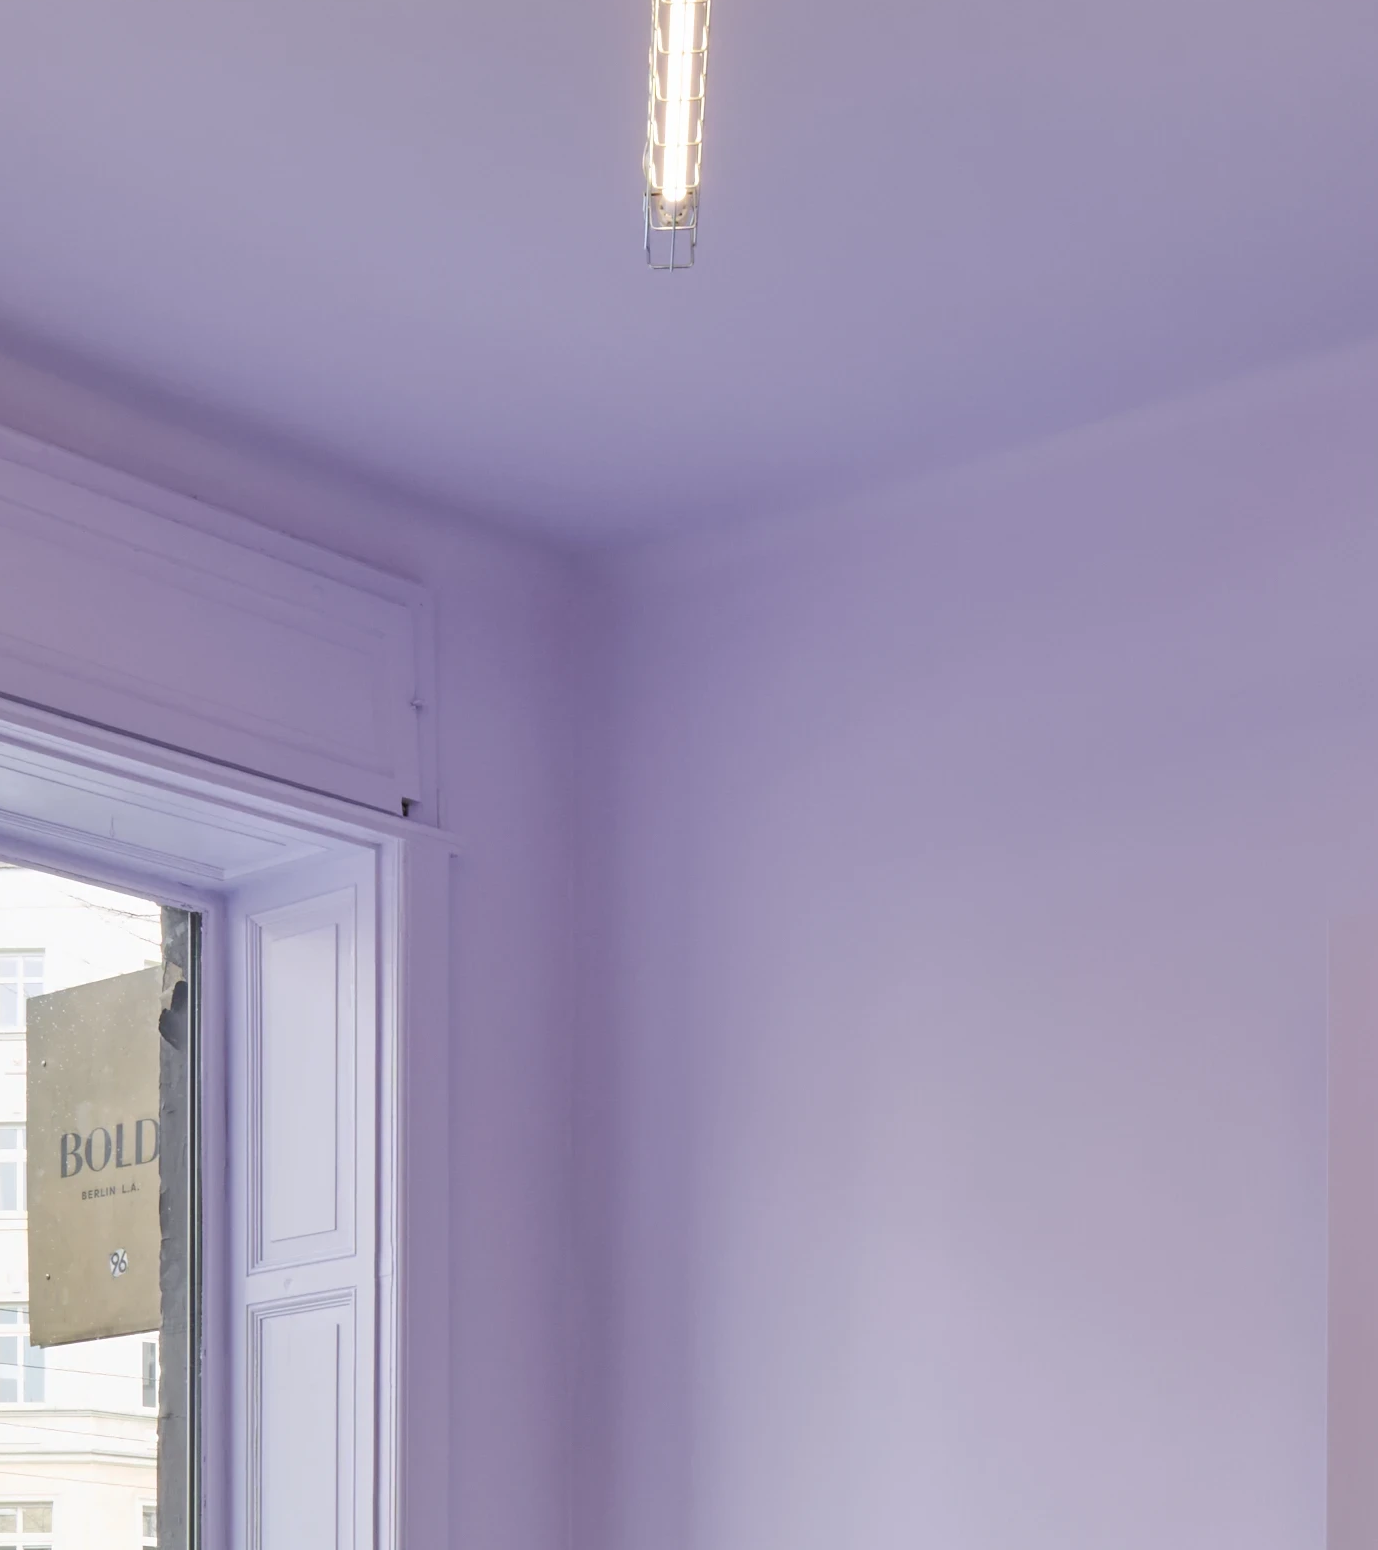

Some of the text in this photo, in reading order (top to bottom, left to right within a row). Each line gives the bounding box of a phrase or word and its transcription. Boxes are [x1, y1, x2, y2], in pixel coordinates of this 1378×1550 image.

[60, 1118, 160, 1178] BOLD
[81, 1182, 140, 1200] BERLIN L.A.
[110, 1250, 128, 1276] 96
